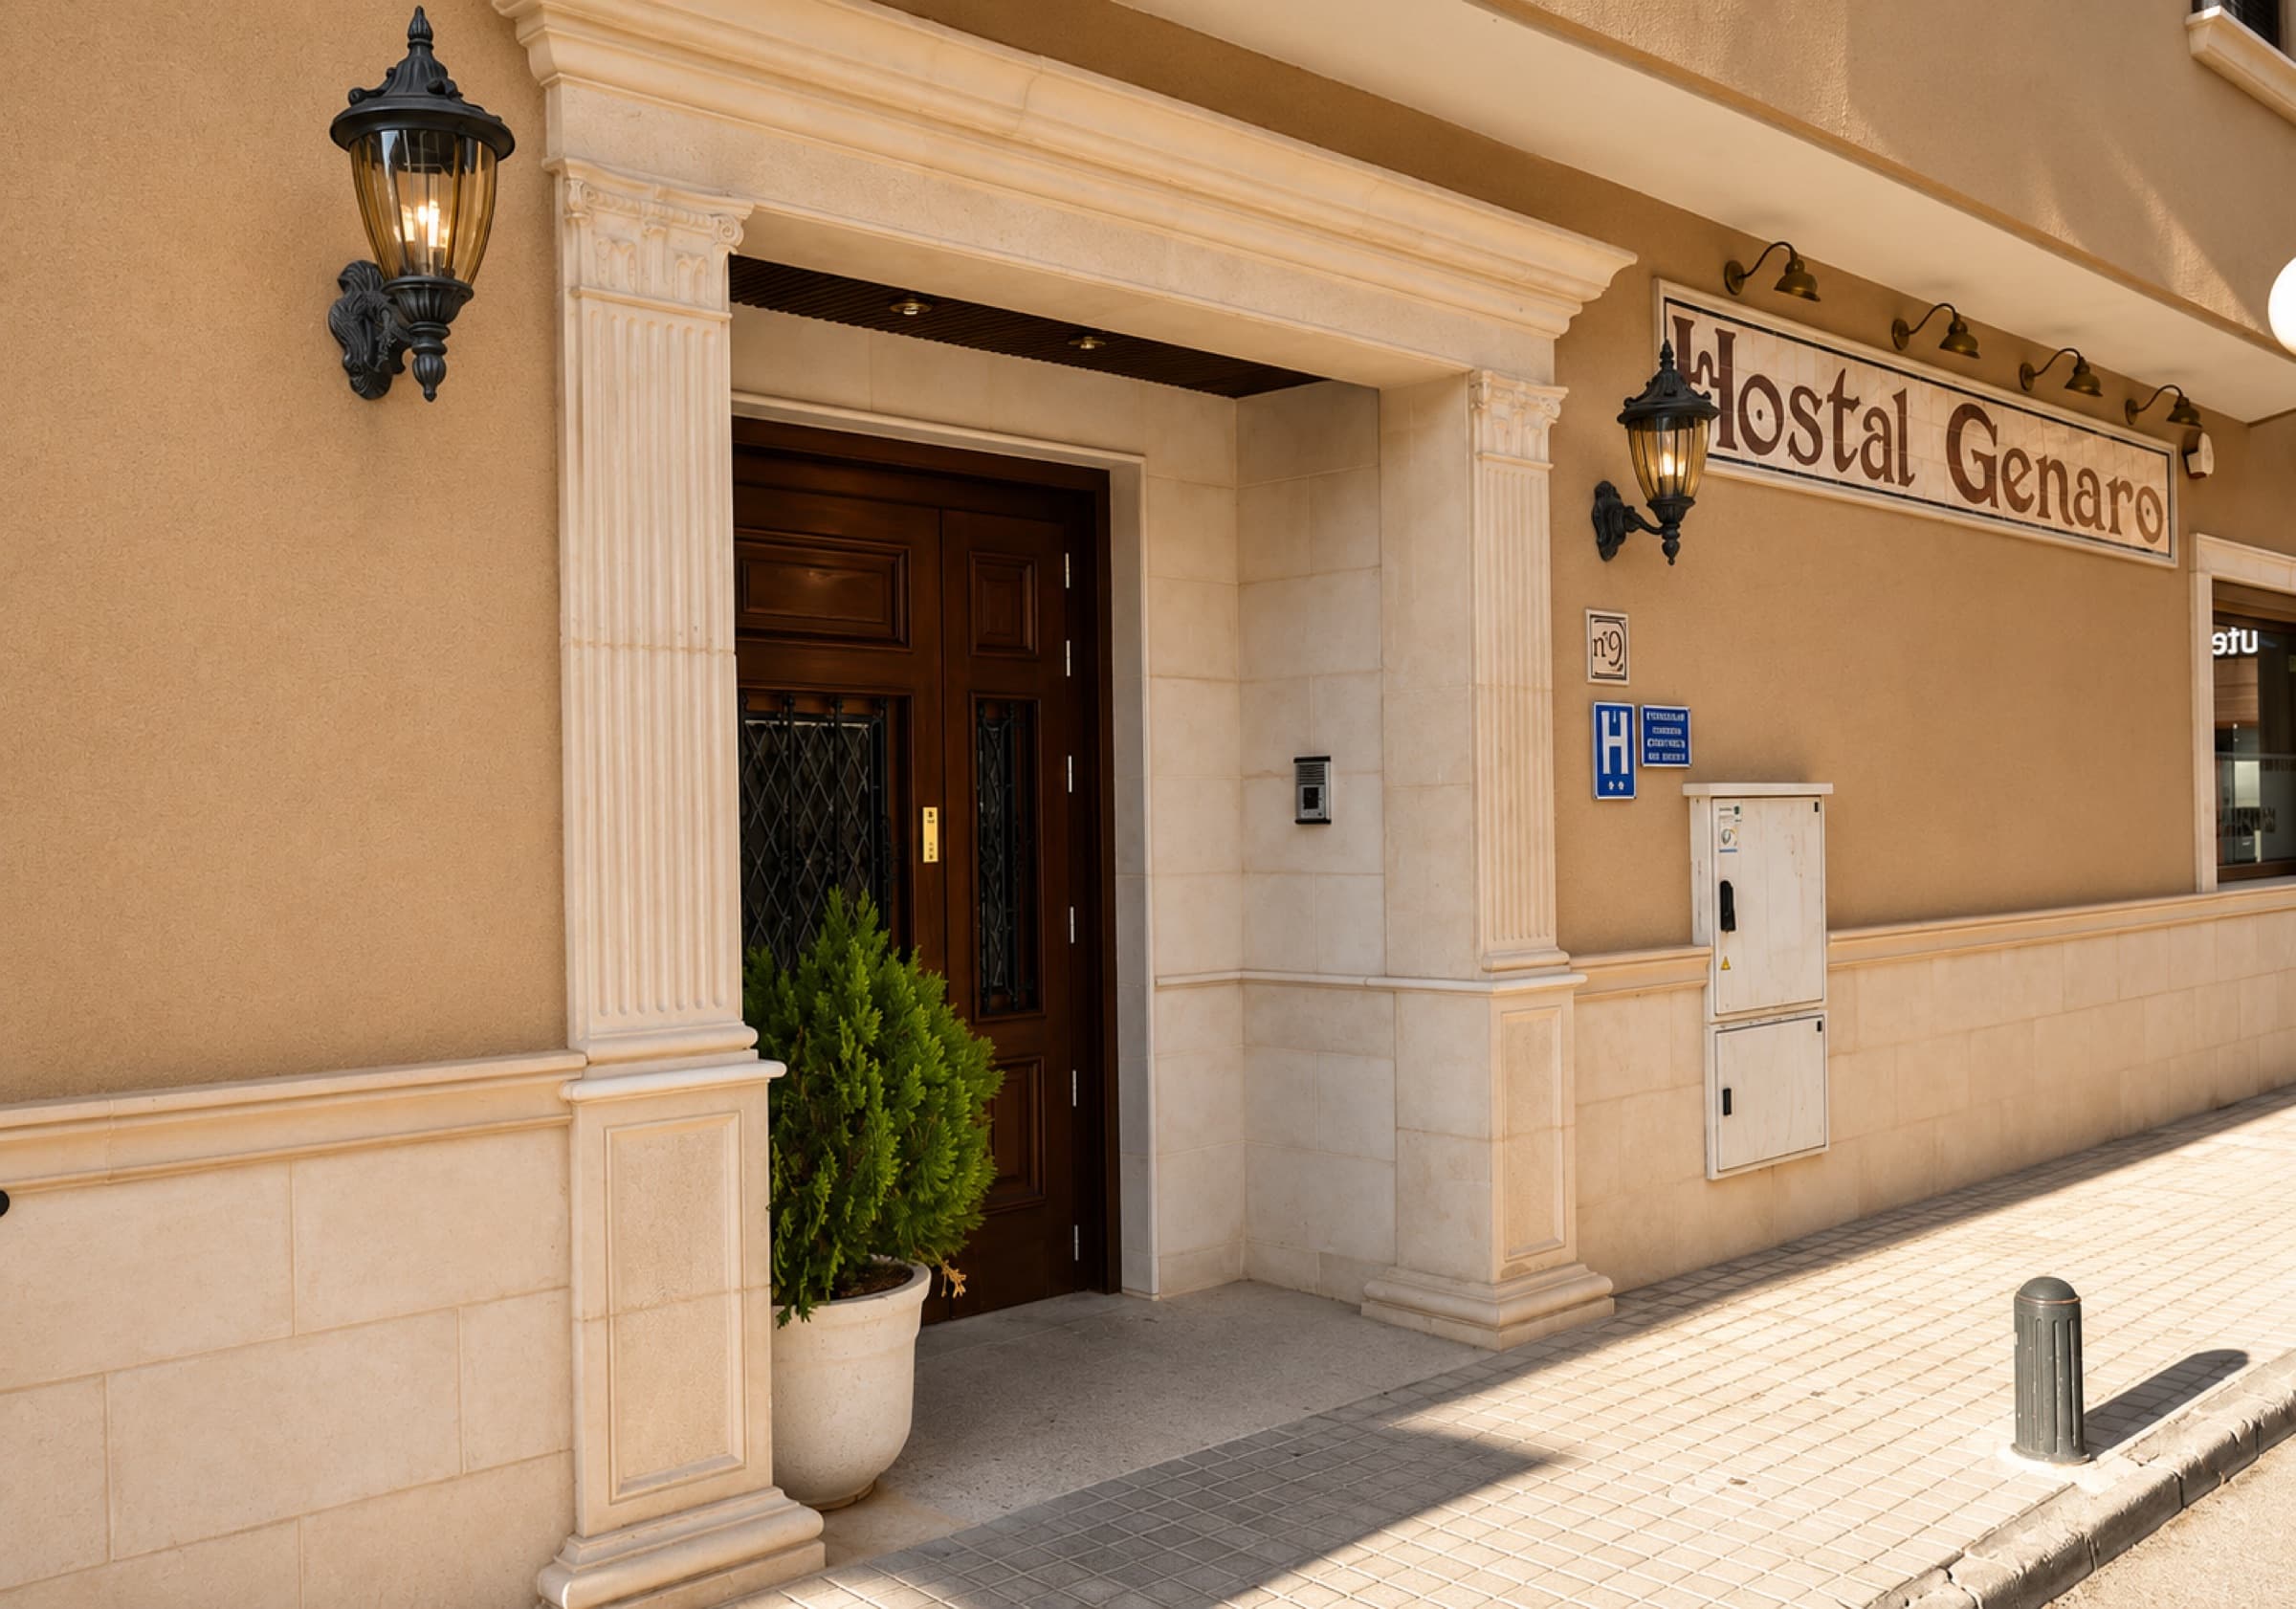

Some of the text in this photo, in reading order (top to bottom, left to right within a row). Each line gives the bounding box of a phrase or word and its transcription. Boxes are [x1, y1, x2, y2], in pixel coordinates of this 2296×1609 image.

[1672, 315, 2163, 544] Hostal Genaro
[1601, 711, 1629, 774] H
